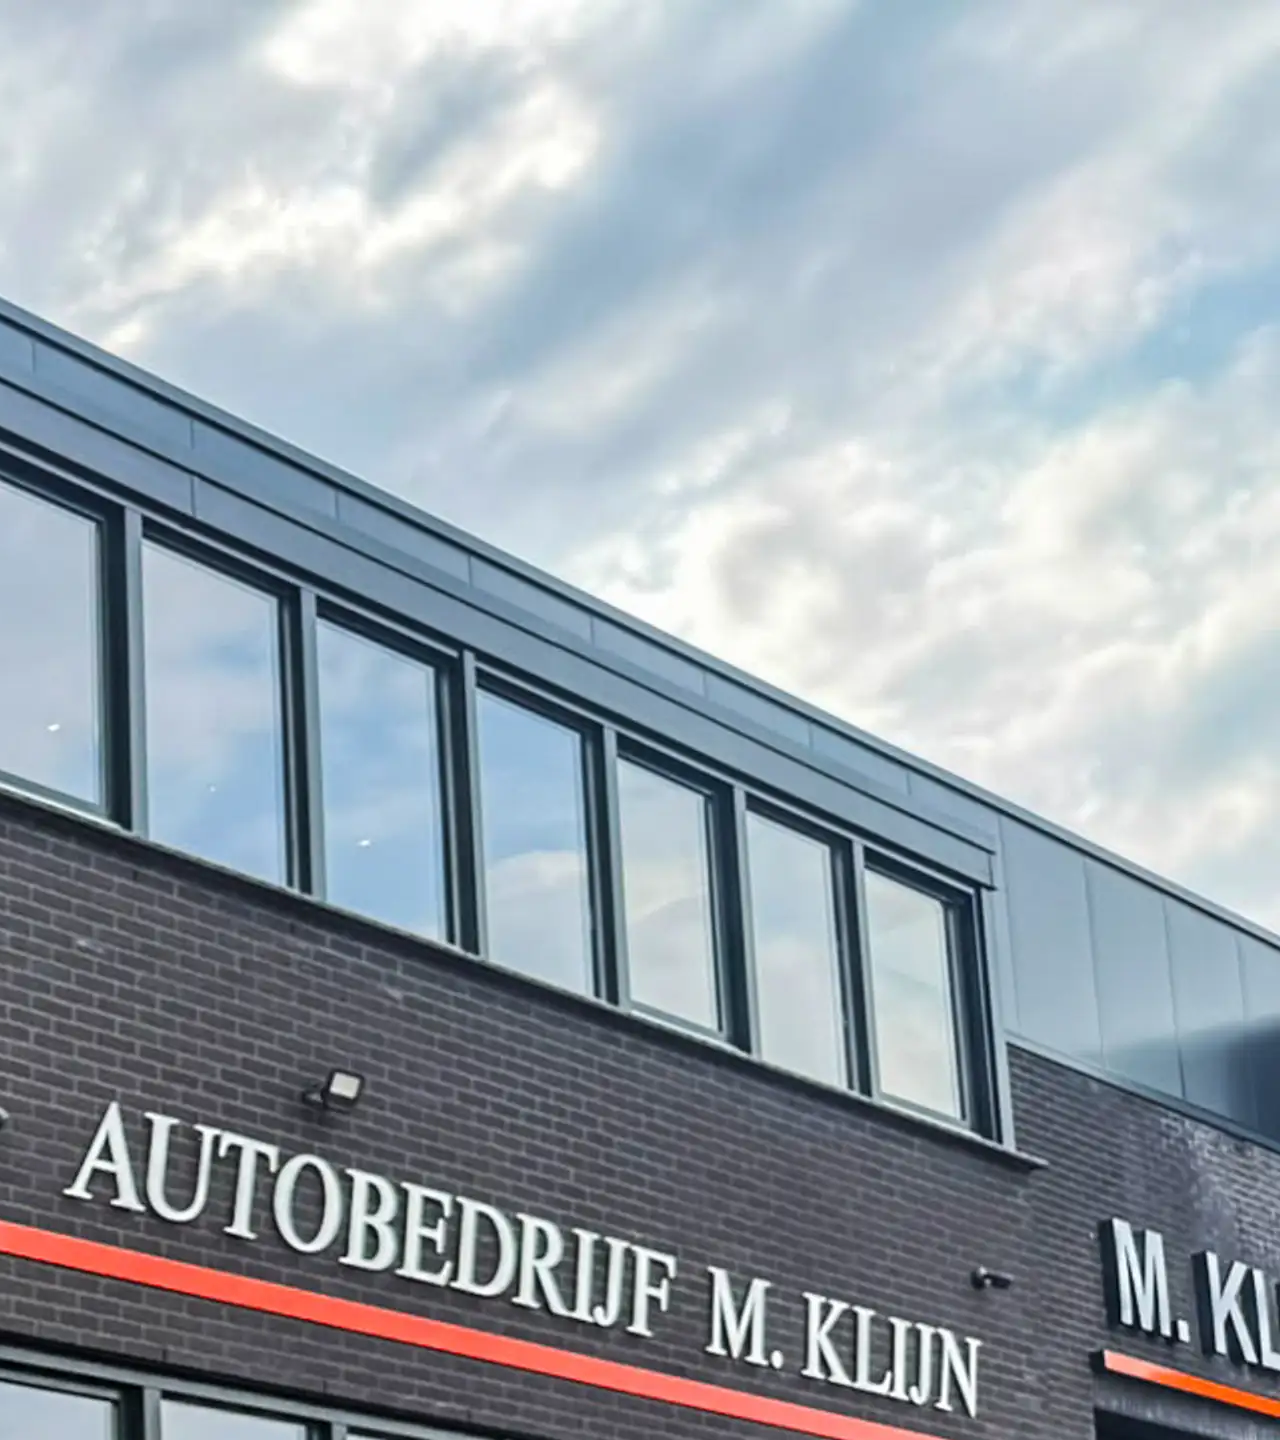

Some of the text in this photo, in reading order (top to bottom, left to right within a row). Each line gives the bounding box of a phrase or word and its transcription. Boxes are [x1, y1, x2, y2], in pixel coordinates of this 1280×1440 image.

[64, 1101, 982, 1419] AUTOBEDRIJF M. KLIJN
[1108, 1216, 1190, 1343] M.
